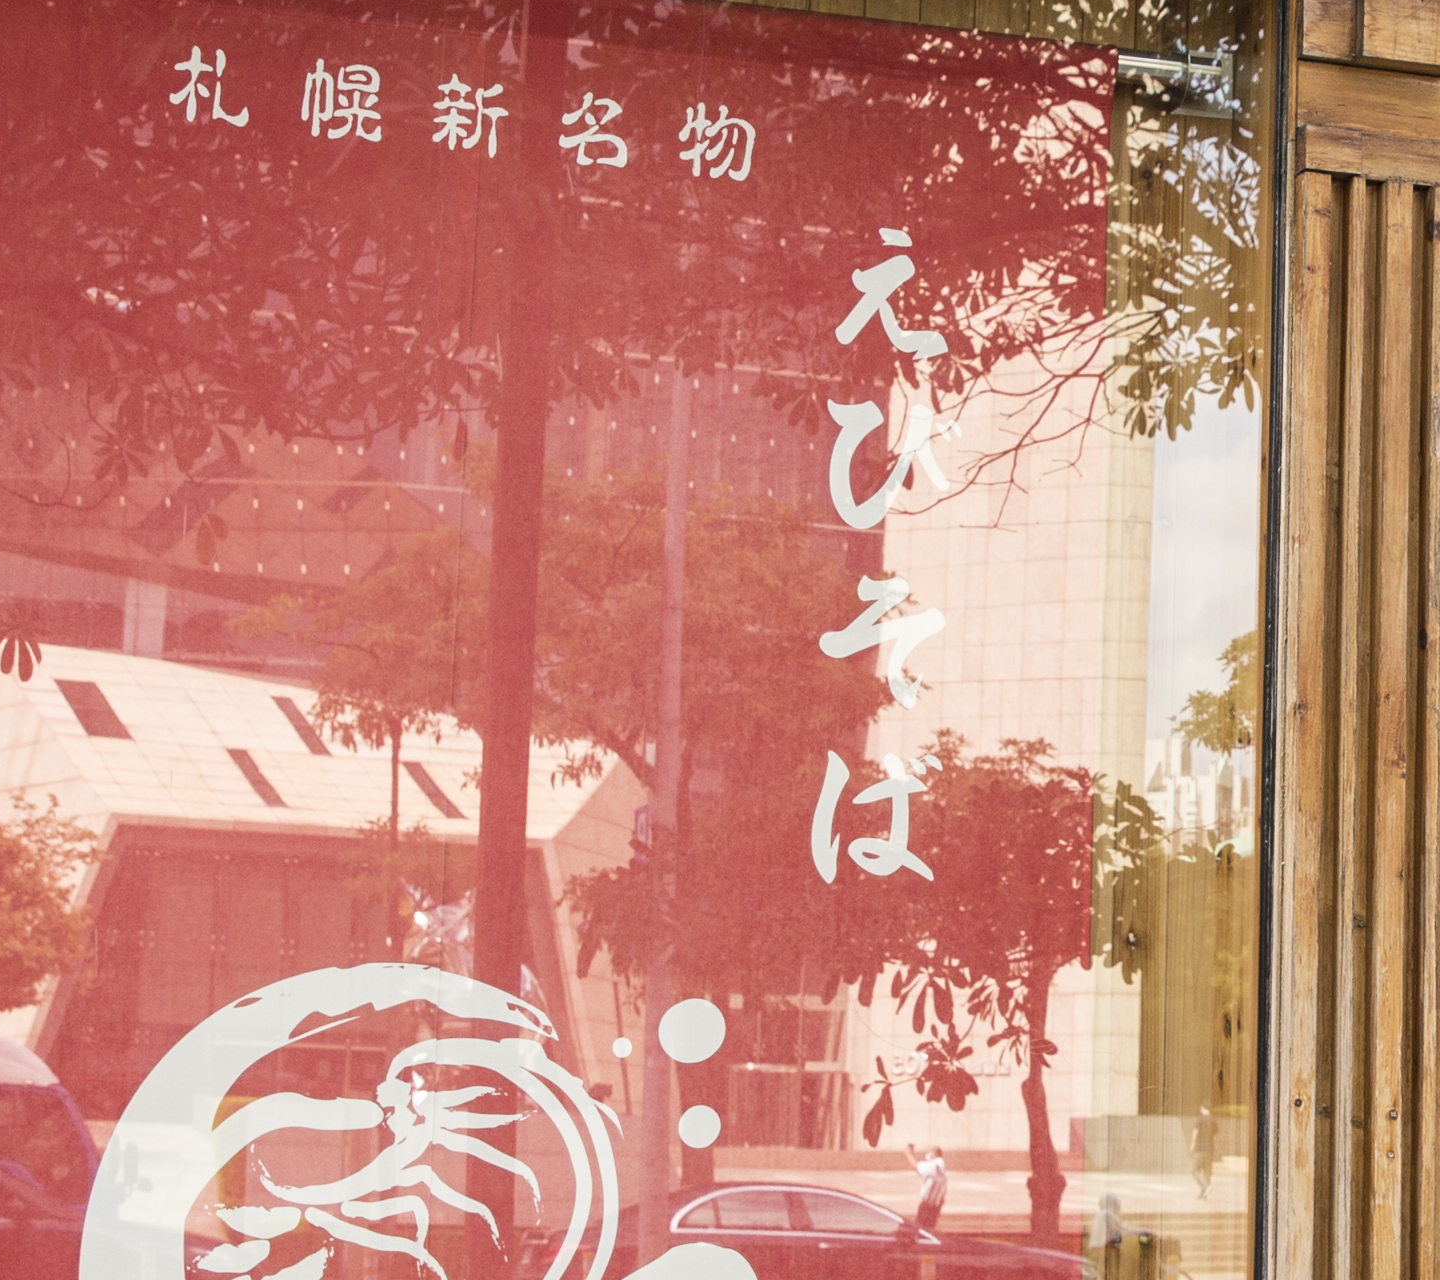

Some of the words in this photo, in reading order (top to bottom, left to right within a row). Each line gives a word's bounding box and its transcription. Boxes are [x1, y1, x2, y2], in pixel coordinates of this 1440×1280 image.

[169, 46, 755, 181] 札幌新名物
[811, 227, 962, 884] えびそば
